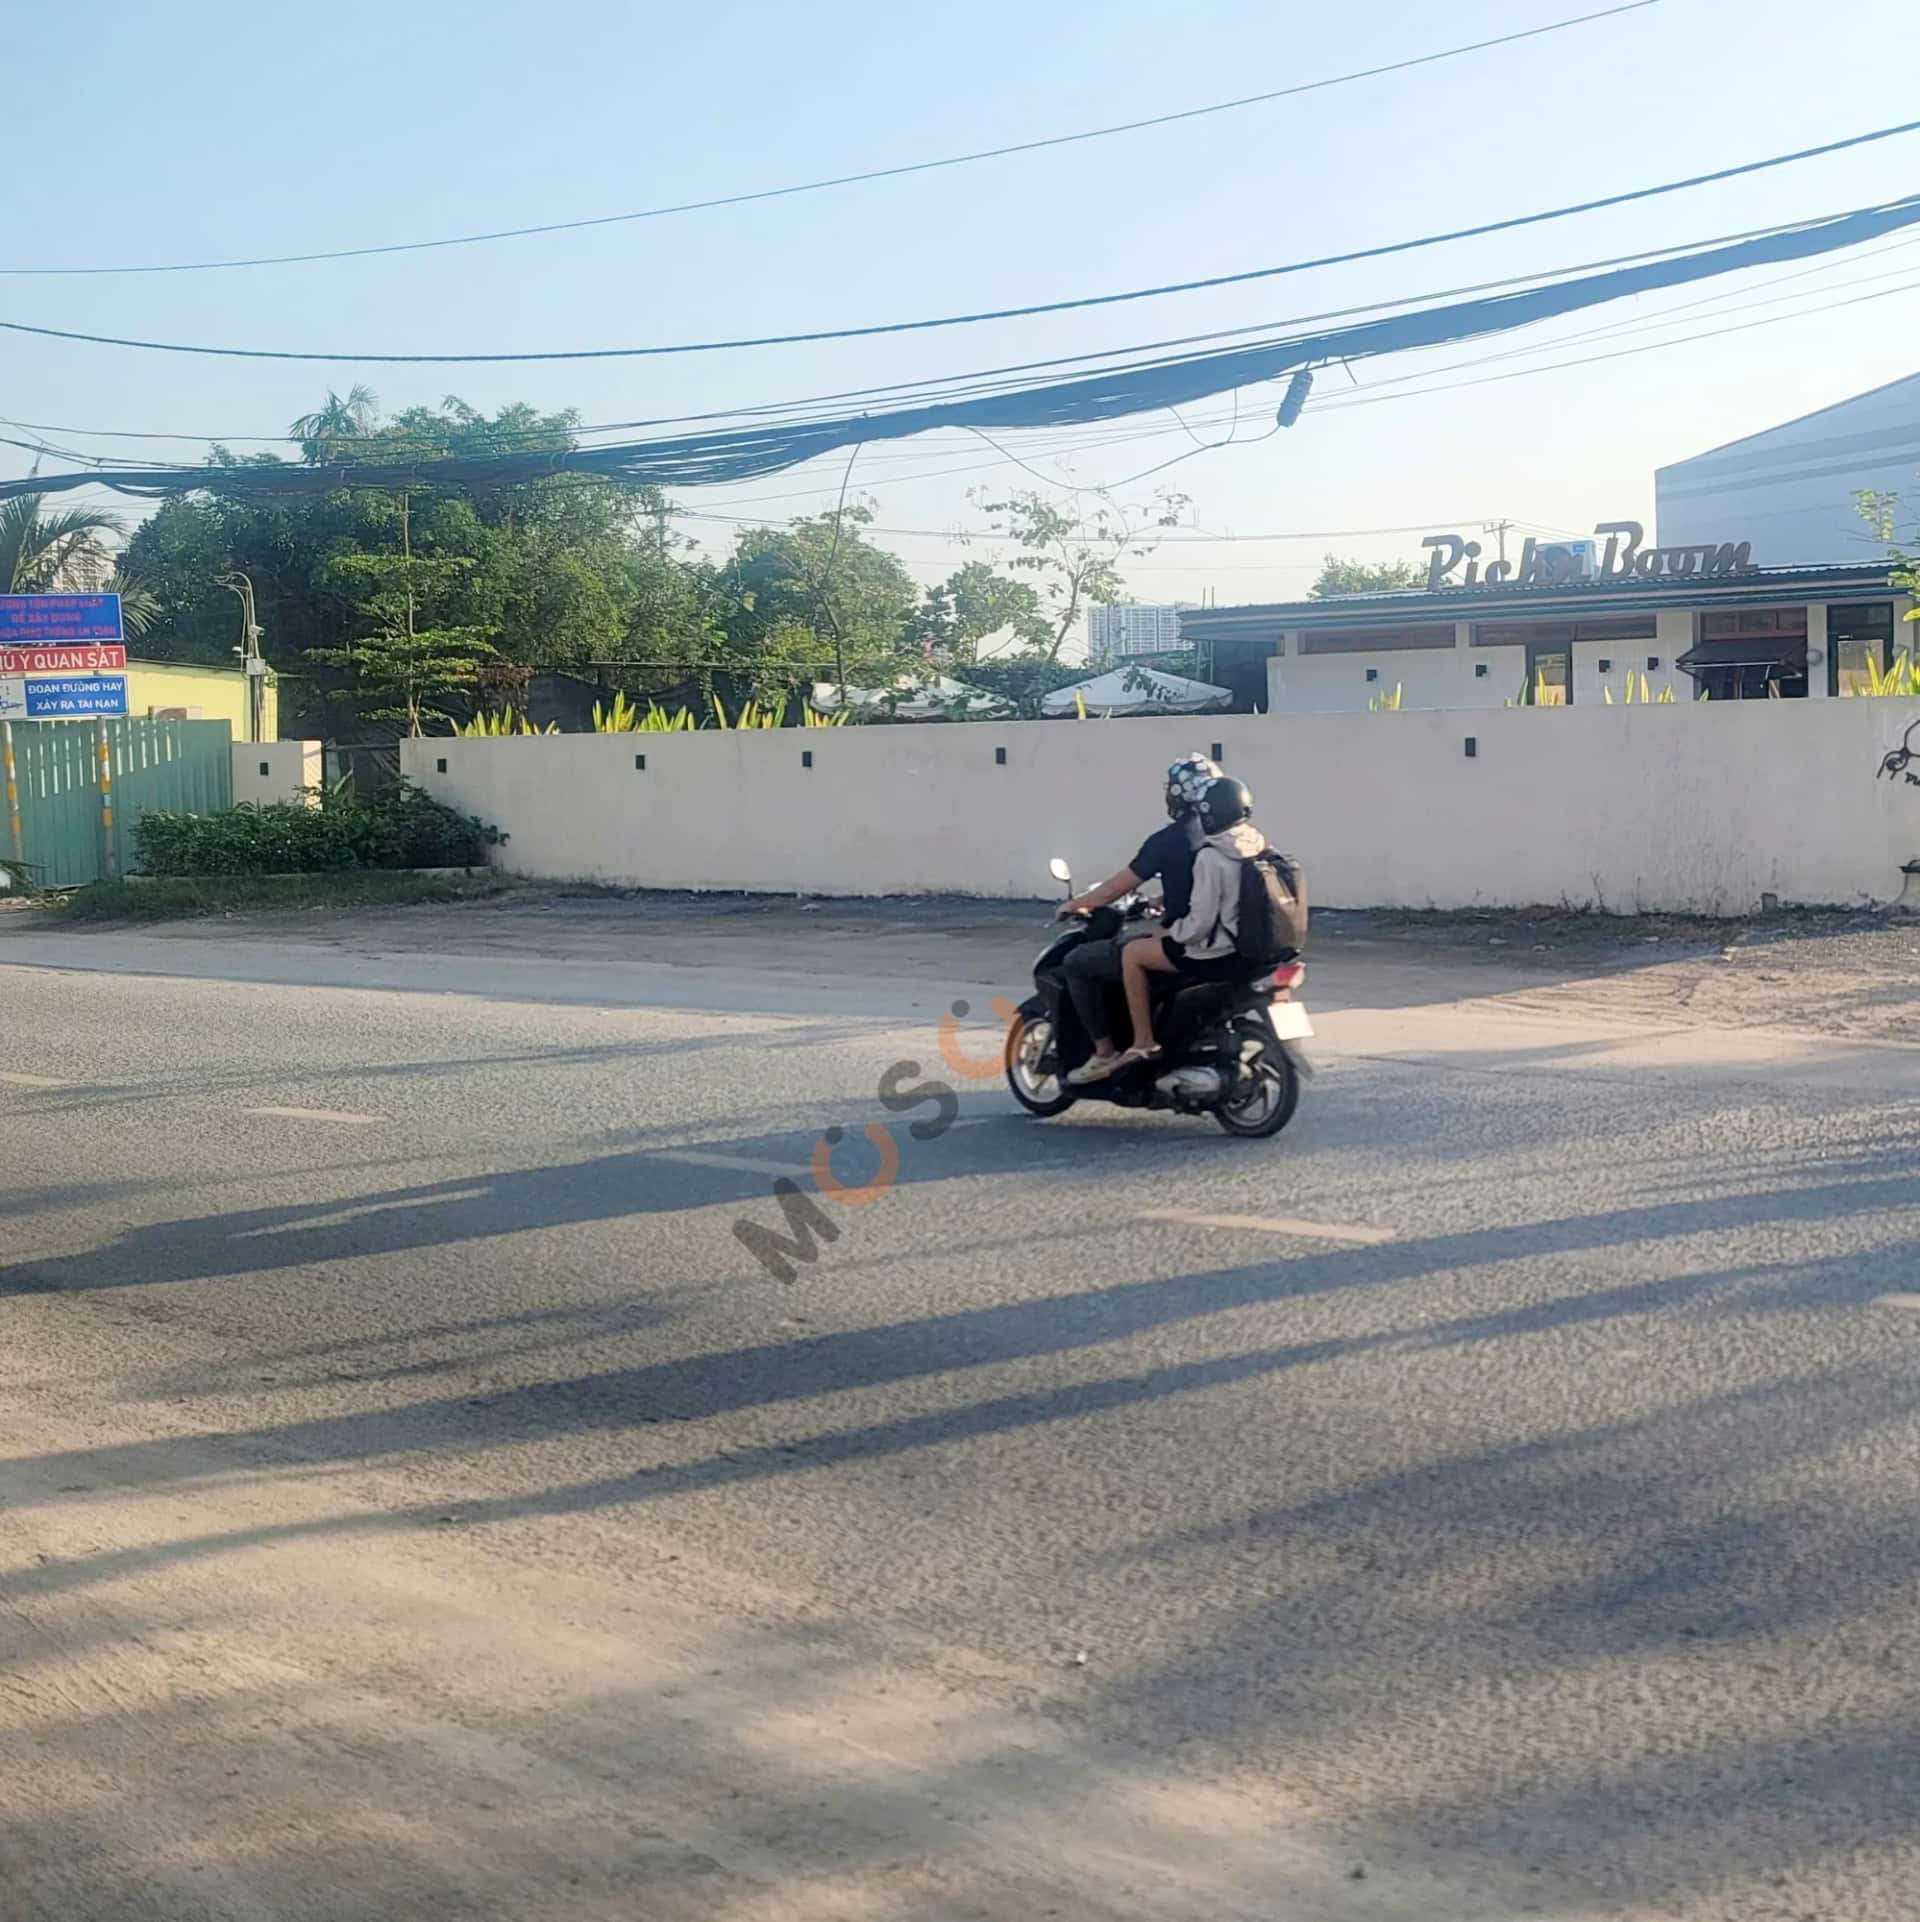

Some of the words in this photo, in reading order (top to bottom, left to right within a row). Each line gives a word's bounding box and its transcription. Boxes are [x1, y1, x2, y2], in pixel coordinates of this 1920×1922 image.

[19, 650, 30, 670] Ý
[34, 653, 84, 669] QUAN
[87, 648, 119, 668] SÁT
[27, 683, 60, 696] ĐOẠN
[103, 682, 123, 692] HAY
[60, 700, 75, 710] RA
[78, 699, 92, 709] TAI
[95, 698, 119, 710] NẠN
